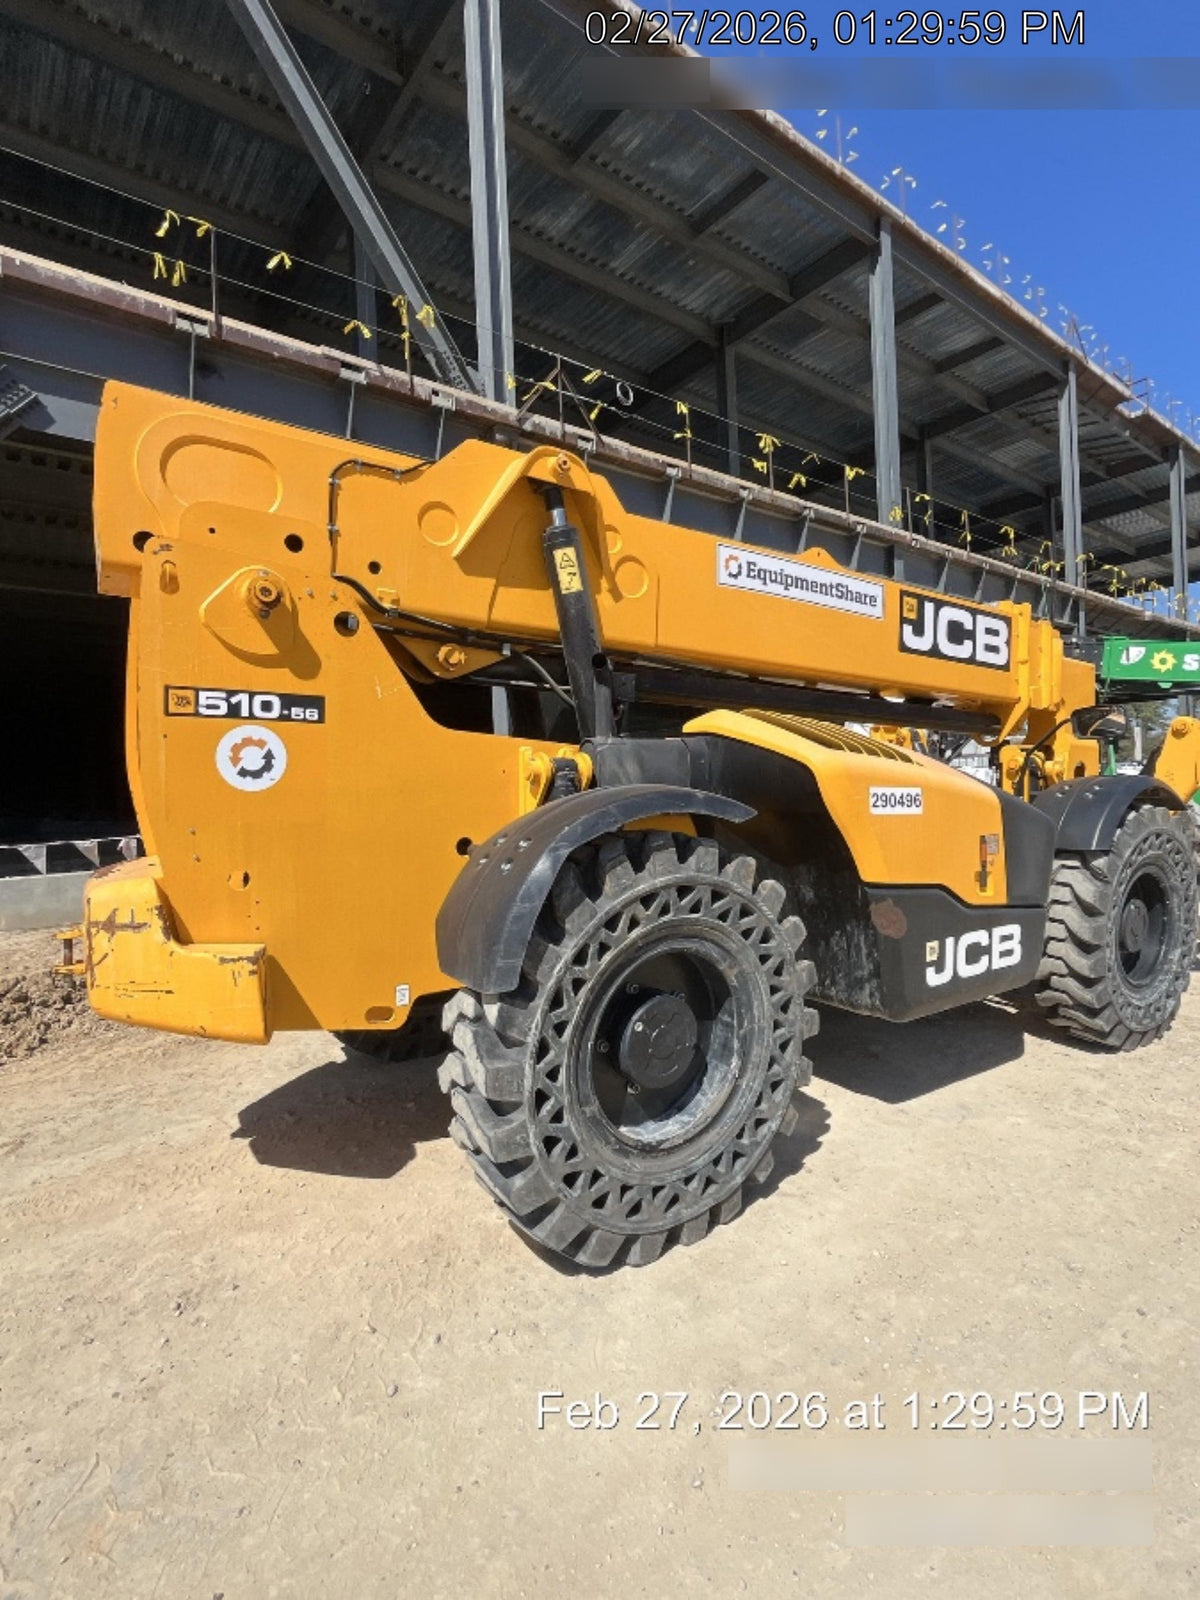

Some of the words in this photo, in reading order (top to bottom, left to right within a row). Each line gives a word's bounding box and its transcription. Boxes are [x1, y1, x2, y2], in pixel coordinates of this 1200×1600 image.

[746, 561, 878, 607] EquipmentShare
[903, 600, 1009, 666] JCB
[871, 792, 922, 809] 290496
[926, 924, 1021, 987] JCB
